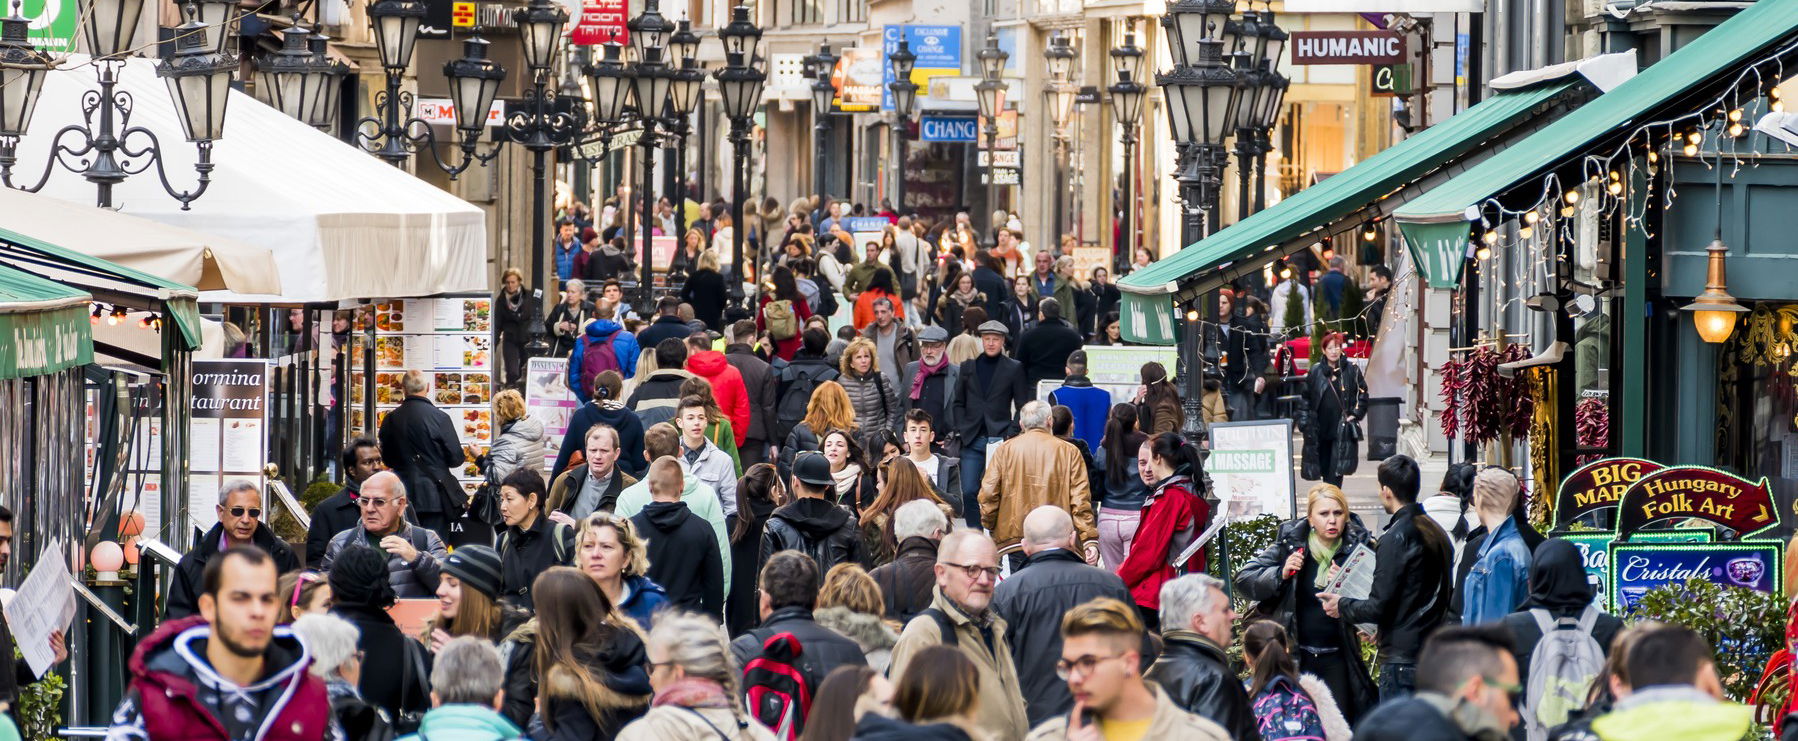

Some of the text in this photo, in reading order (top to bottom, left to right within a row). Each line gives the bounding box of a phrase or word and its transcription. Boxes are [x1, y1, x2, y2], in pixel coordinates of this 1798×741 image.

[1297, 37, 1400, 57] HUMANIC
[923, 121, 977, 138] CHANG
[983, 153, 1015, 163] CANGE
[981, 174, 1019, 184] MSSAGE
[192, 368, 262, 386] ormina
[191, 395, 262, 410] taurant
[1215, 453, 1272, 471] MASSAGE
[1590, 463, 1641, 486] BIG
[1573, 484, 1625, 507] MAR
[1643, 478, 1742, 498] Hungary
[1642, 494, 1736, 520] Folk Art
[1621, 555, 1713, 582] Cristals
